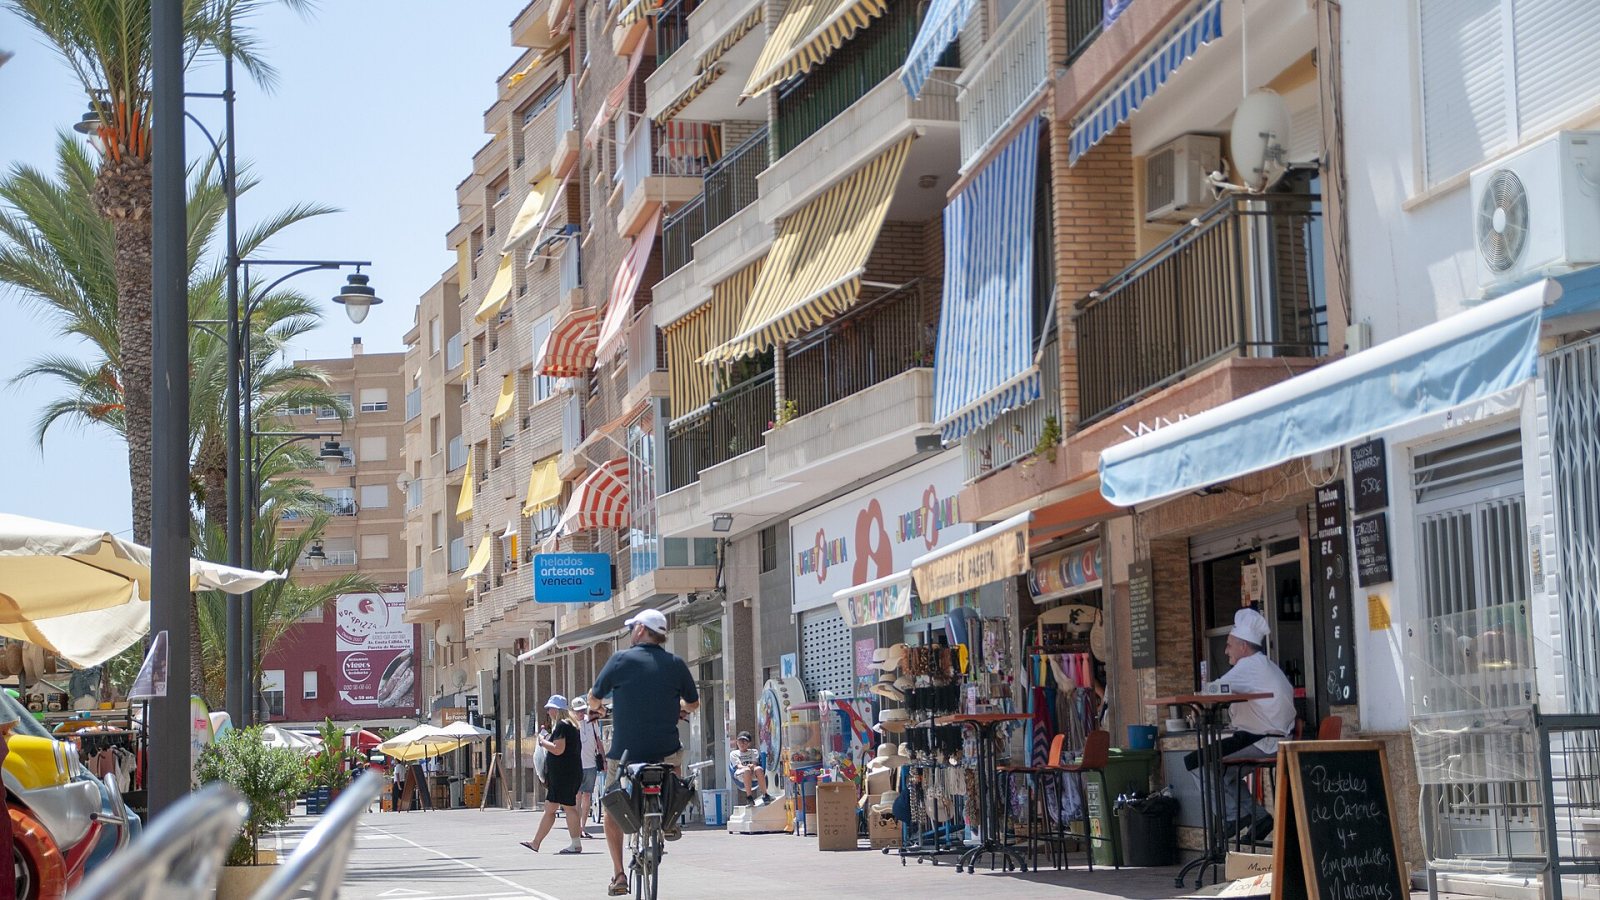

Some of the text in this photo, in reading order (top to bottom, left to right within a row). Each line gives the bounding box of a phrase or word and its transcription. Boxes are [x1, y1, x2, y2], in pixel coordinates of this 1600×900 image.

[1318, 489, 1338, 503] Mahou
[1324, 517, 1335, 526] BAR
[540, 557, 583, 567] helados
[540, 567, 595, 576] artesanos
[541, 576, 582, 586] venecia
[1321, 541, 1350, 699] EL PASEITO
[1310, 765, 1367, 792] Pasteles
[1312, 795, 1381, 823] de Carne
